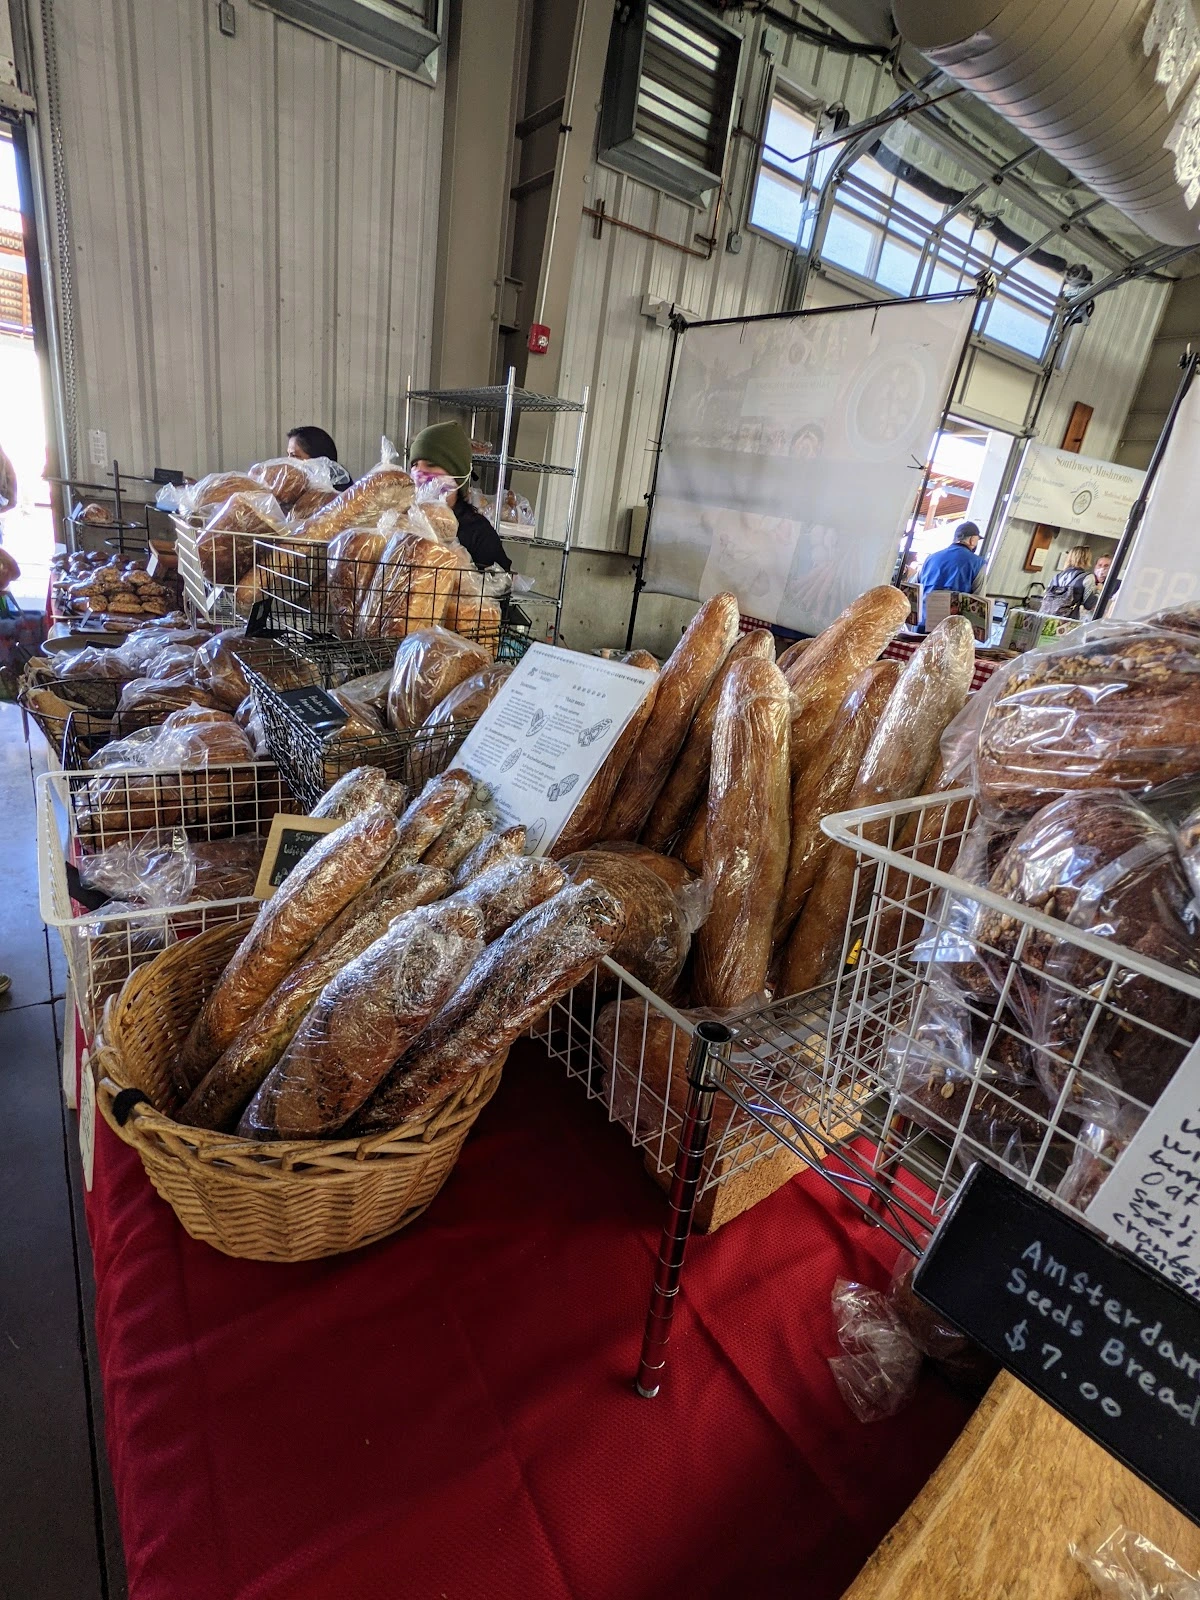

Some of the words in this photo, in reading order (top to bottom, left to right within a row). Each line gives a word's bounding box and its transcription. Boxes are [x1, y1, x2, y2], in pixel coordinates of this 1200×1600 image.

[1054, 455, 1093, 474] Southwest
[1093, 464, 1133, 483] Mushrooms
[1006, 1267, 1085, 1337] Seeds
[1099, 1337, 1200, 1427] Bread
[1020, 1240, 1200, 1379] Amsterdam
